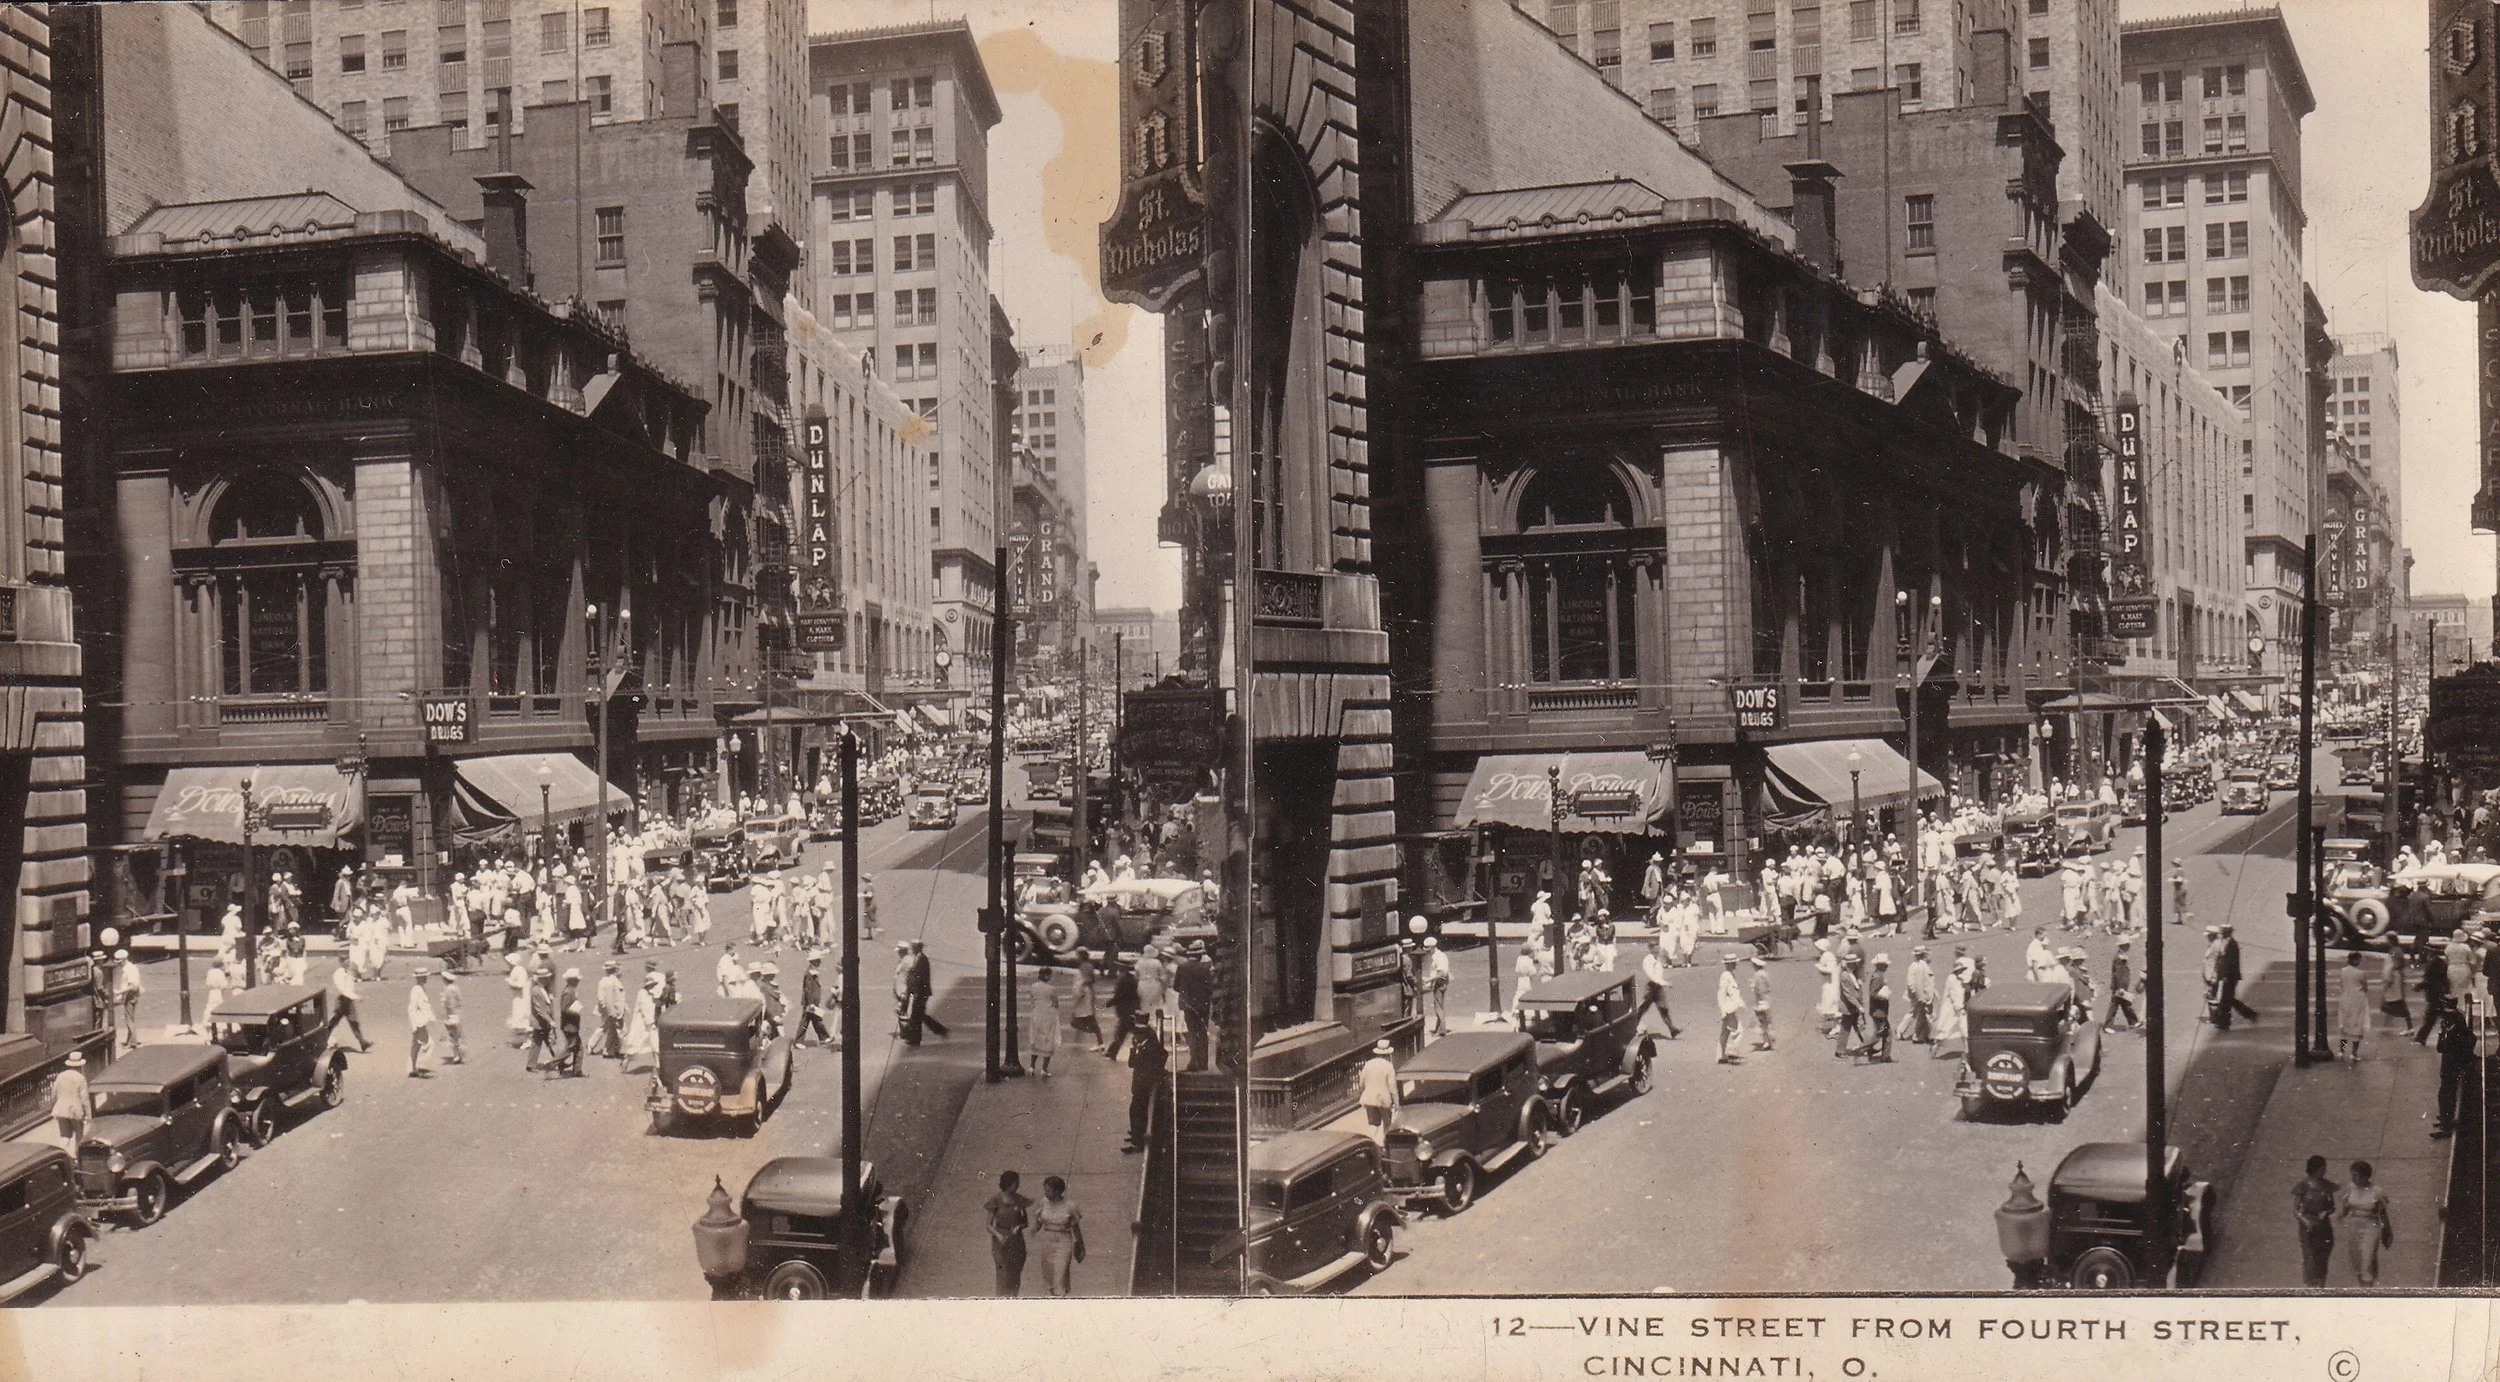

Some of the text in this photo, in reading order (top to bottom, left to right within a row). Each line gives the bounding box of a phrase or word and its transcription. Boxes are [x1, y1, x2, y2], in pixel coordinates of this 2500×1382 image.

[1140, 189, 1170, 229] St.
[810, 425, 827, 566] DUNLAP
[2121, 413, 2138, 553] DUNLAP
[1041, 523, 1054, 603] GRAND
[2355, 509, 2369, 589] GRAND
[1560, 614, 1604, 623] NATIONAL
[426, 701, 467, 722] DOW'S
[1736, 687, 1777, 709] DOW'S
[431, 725, 464, 740] DRUGS
[1741, 712, 1774, 727] DRUGS
